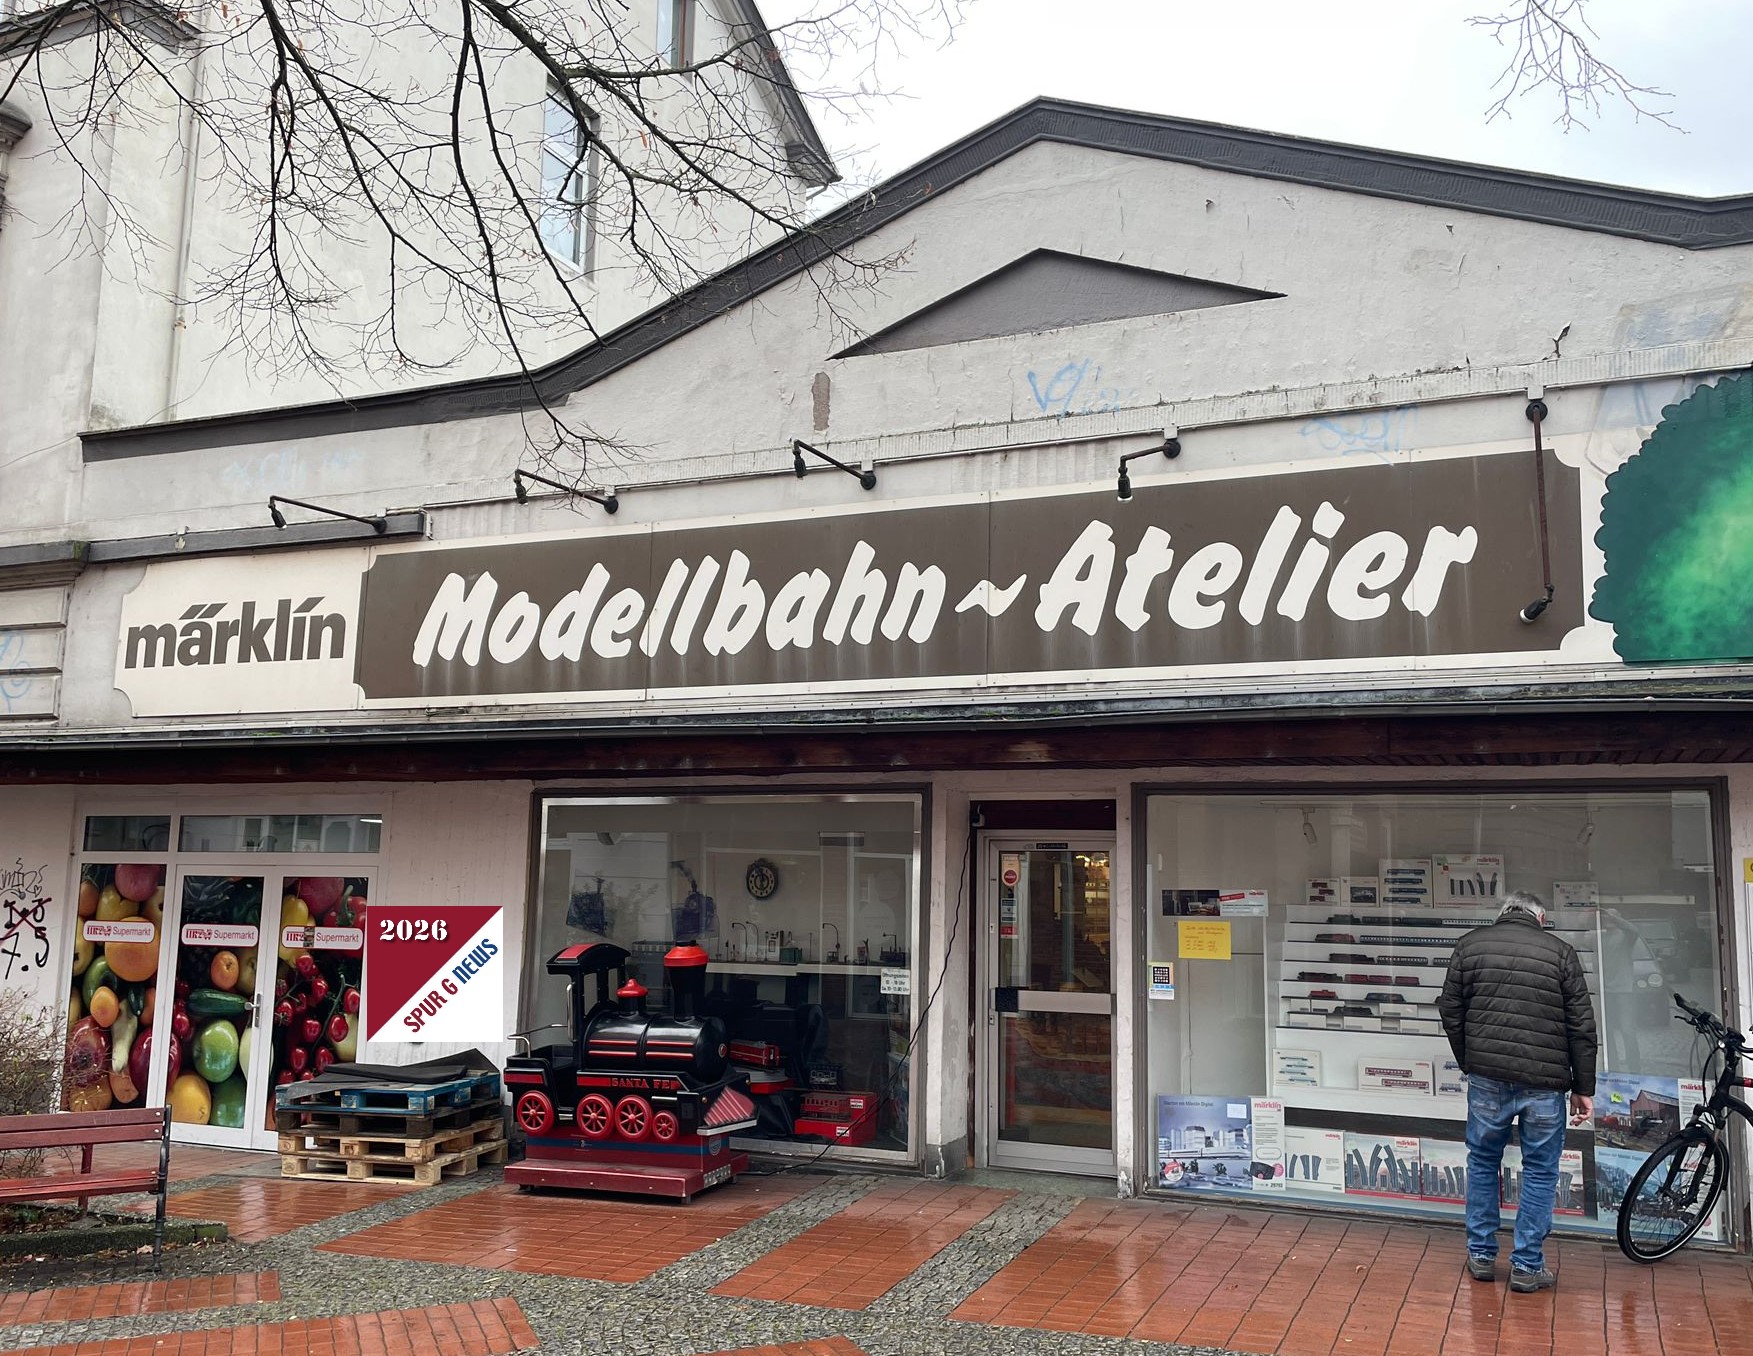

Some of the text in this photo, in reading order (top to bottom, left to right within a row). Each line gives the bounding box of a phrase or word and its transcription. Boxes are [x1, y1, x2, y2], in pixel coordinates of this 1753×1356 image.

[112, 926, 151, 936] Supermarkt
[214, 930, 254, 940] Supermarkt
[316, 932, 359, 944] Supermarkt
[612, 1077, 670, 1089] SANTA FE
